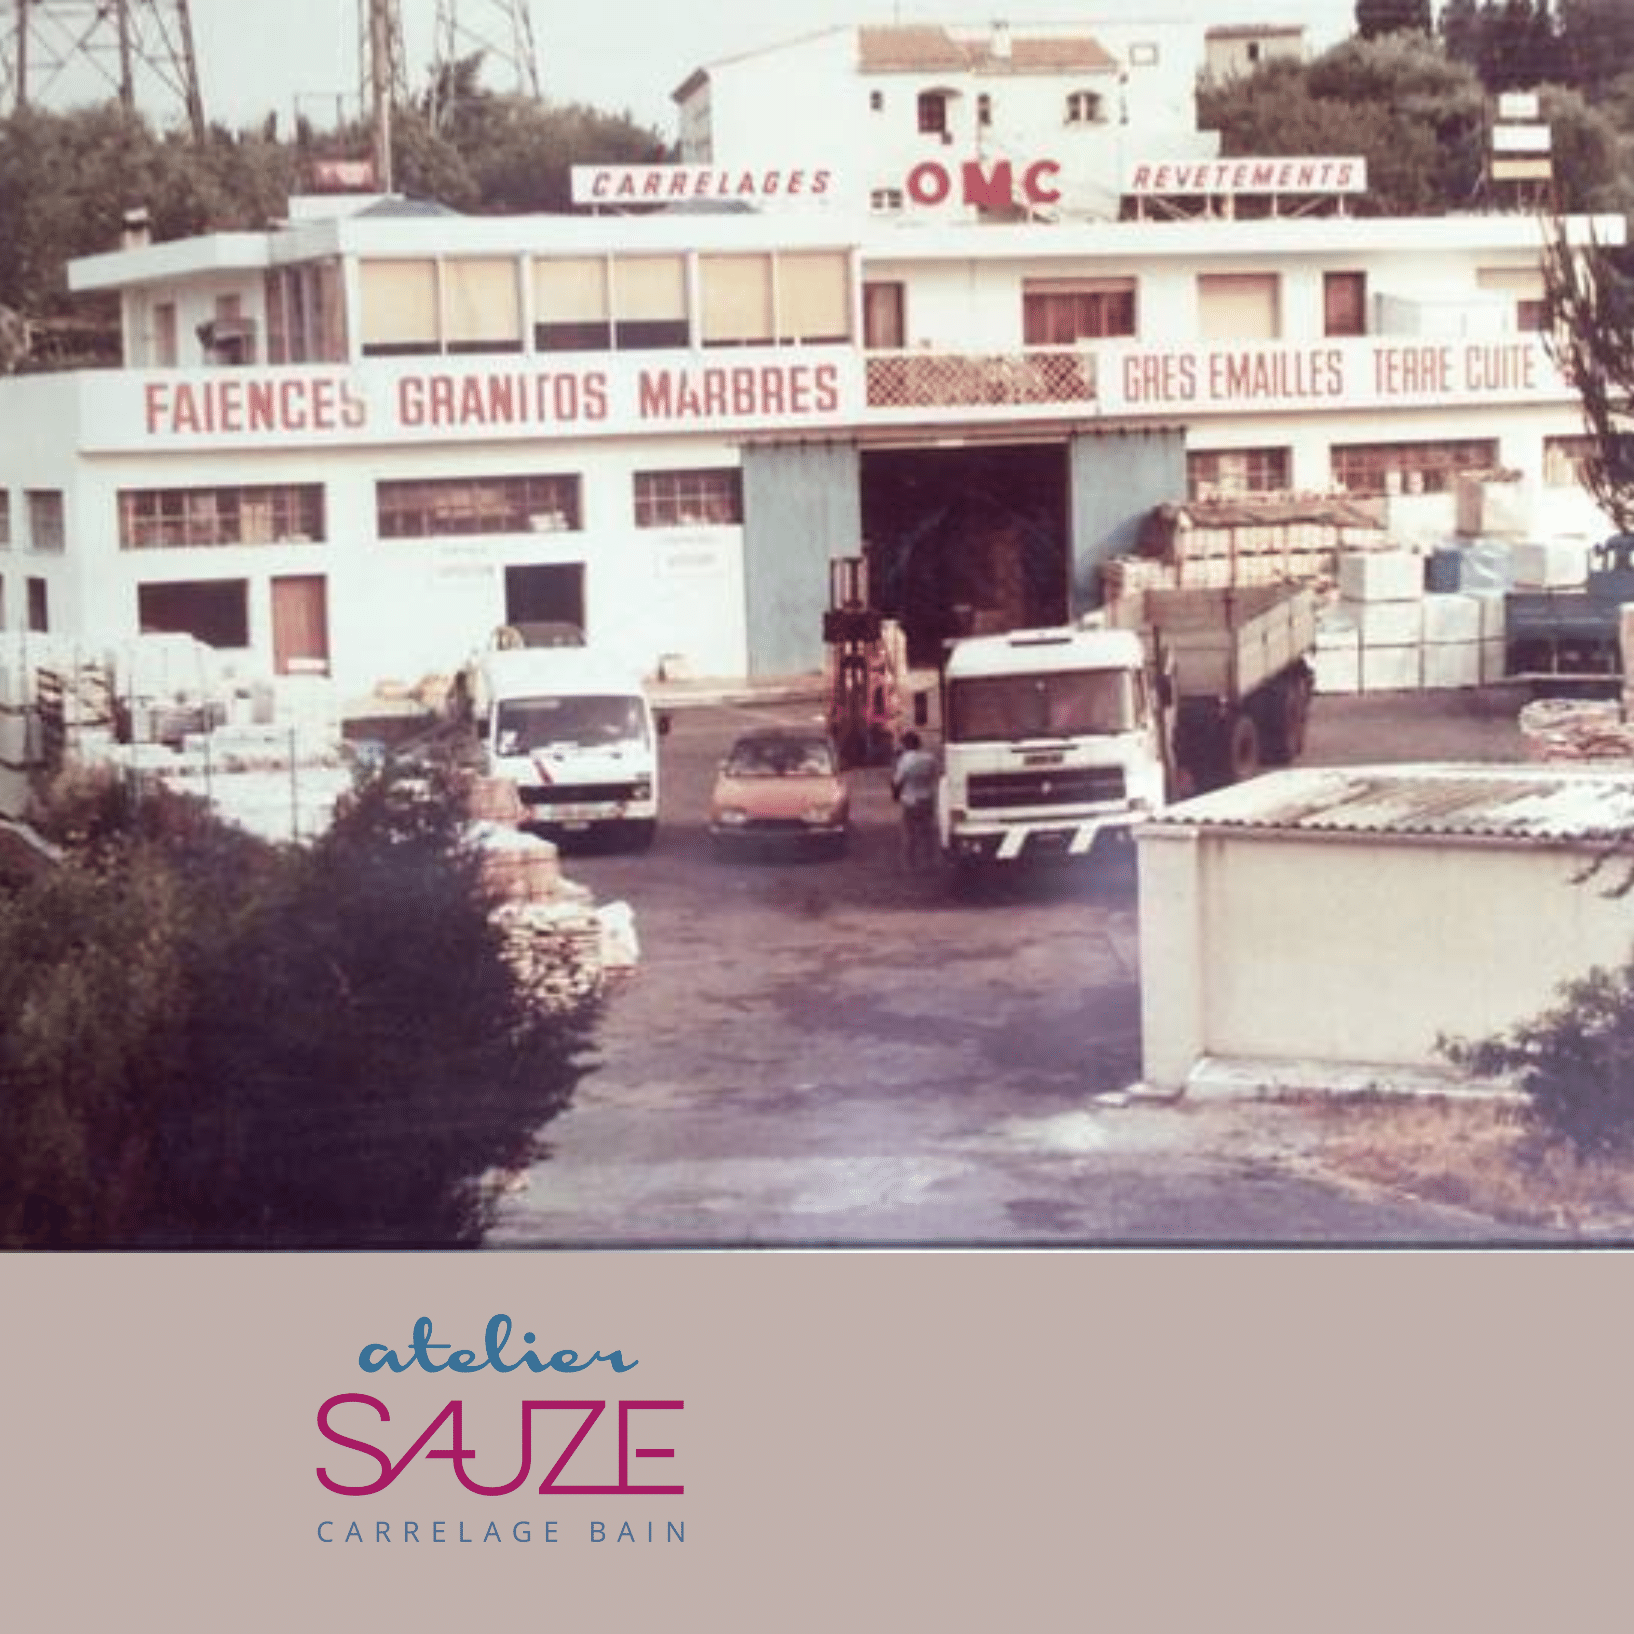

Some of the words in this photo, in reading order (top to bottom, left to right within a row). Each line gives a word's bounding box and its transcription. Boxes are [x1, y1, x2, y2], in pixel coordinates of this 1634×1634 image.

[592, 170, 832, 196] CARRELAGES
[906, 159, 1061, 206] OMC
[1133, 163, 1353, 188] REVETEMENTS
[1123, 353, 1197, 403] GRES
[1209, 349, 1343, 399] EMAILLES
[1373, 347, 1452, 394] TERRE
[1466, 343, 1536, 390] CUITE
[144, 379, 367, 434] FAIENCES
[399, 372, 607, 428] GRANITOS
[639, 364, 838, 419] MARBRES
